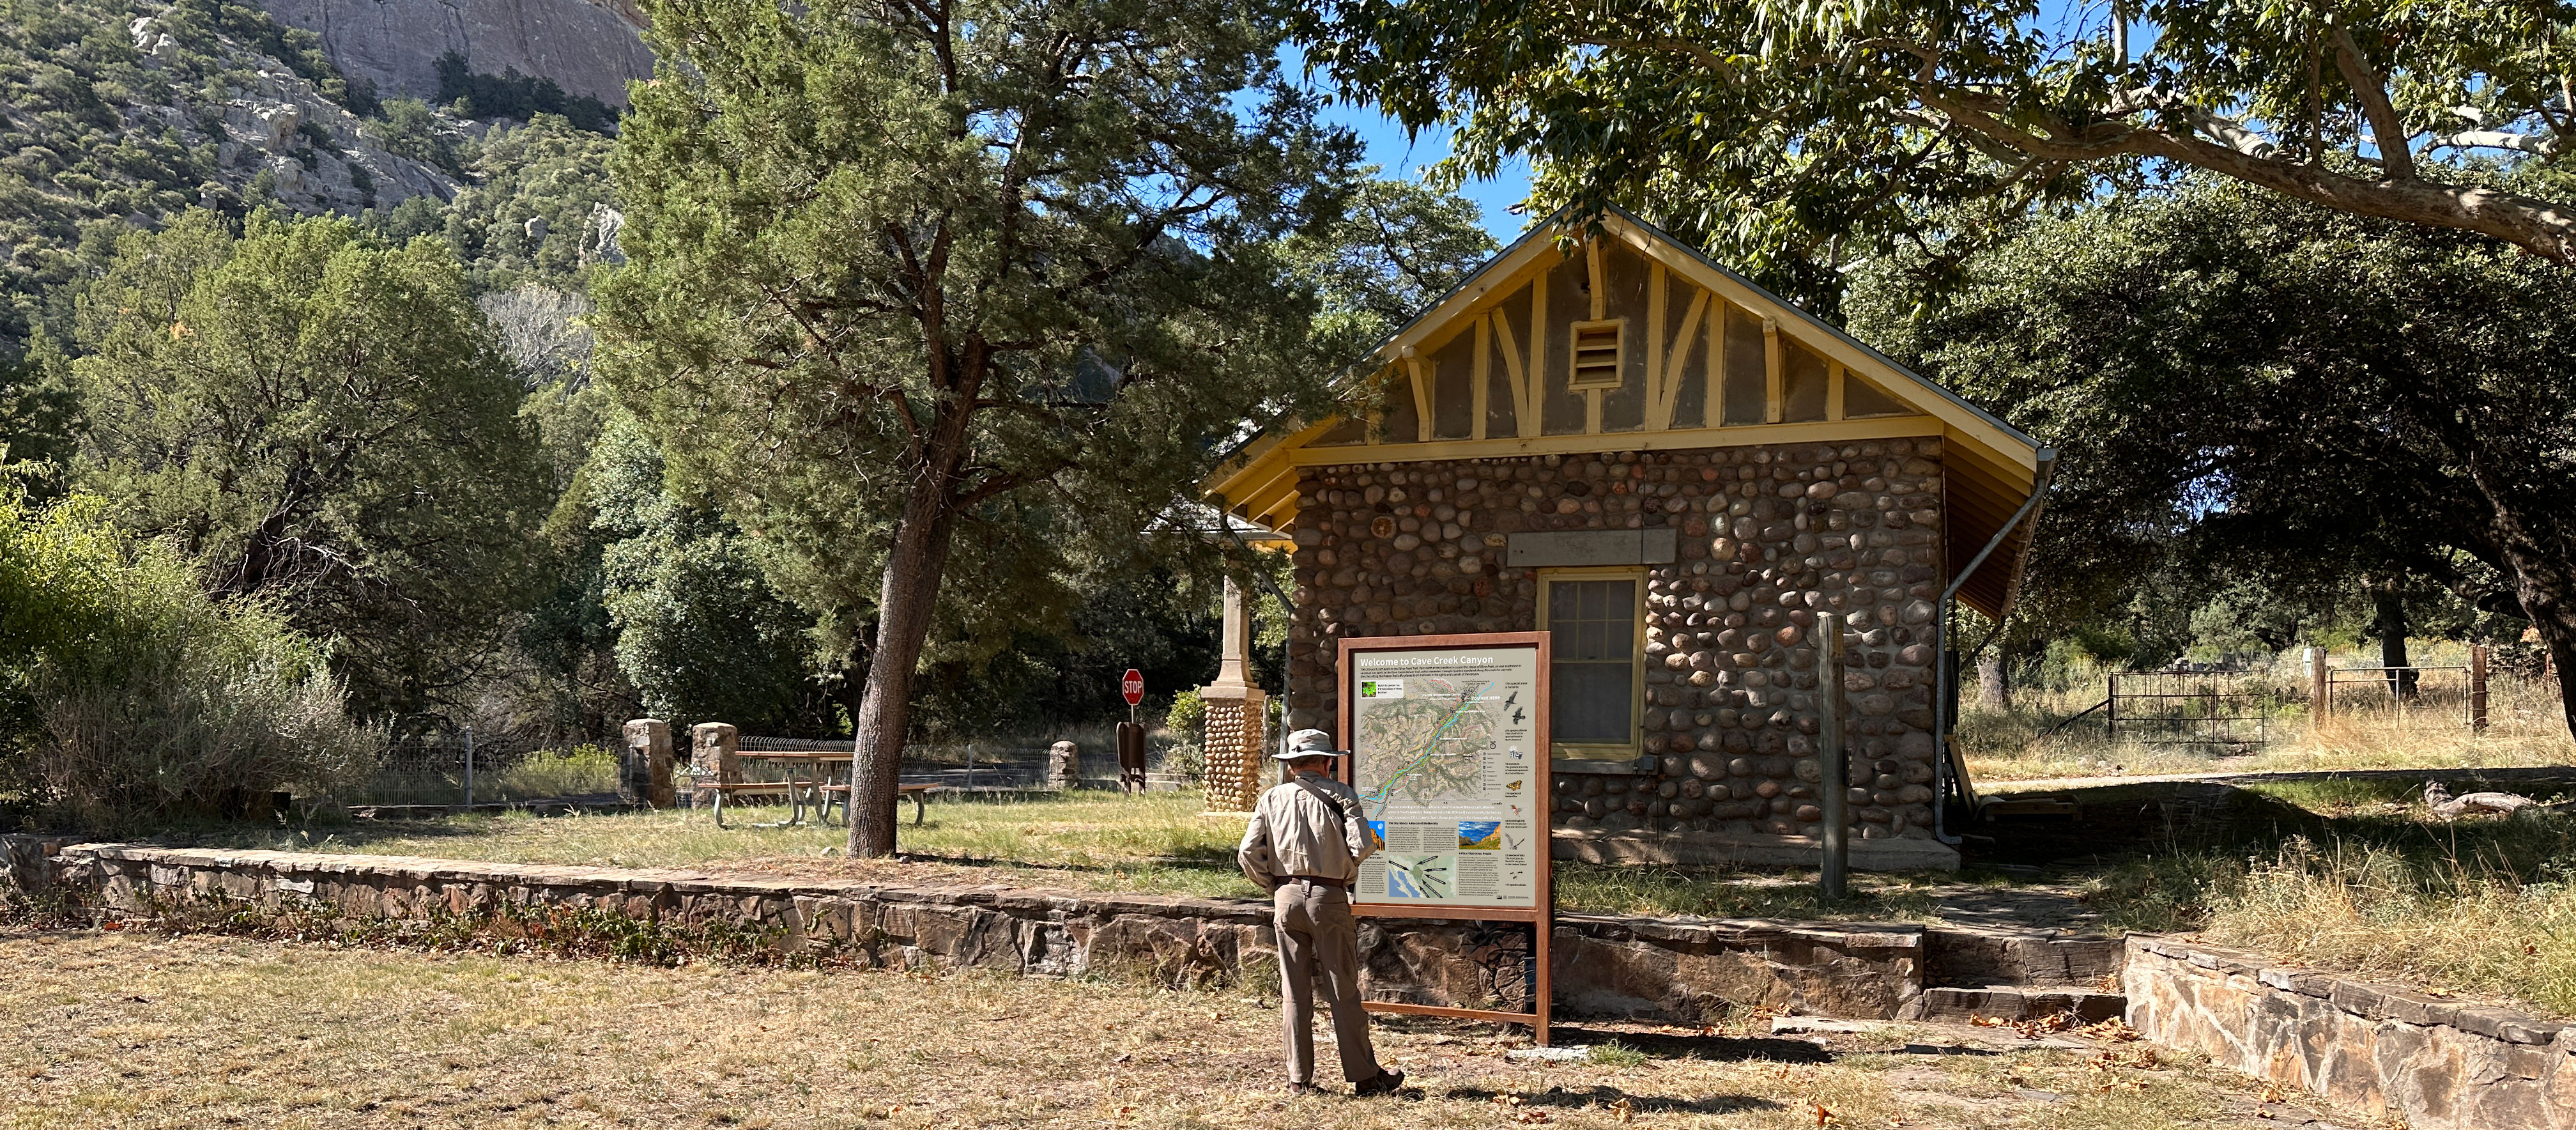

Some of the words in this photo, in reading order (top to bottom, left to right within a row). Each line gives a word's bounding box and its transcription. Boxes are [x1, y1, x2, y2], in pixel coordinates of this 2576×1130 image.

[1434, 656, 1459, 664] Creek
[1460, 656, 1493, 665] Canyon
[1124, 681, 1142, 694] STOP
